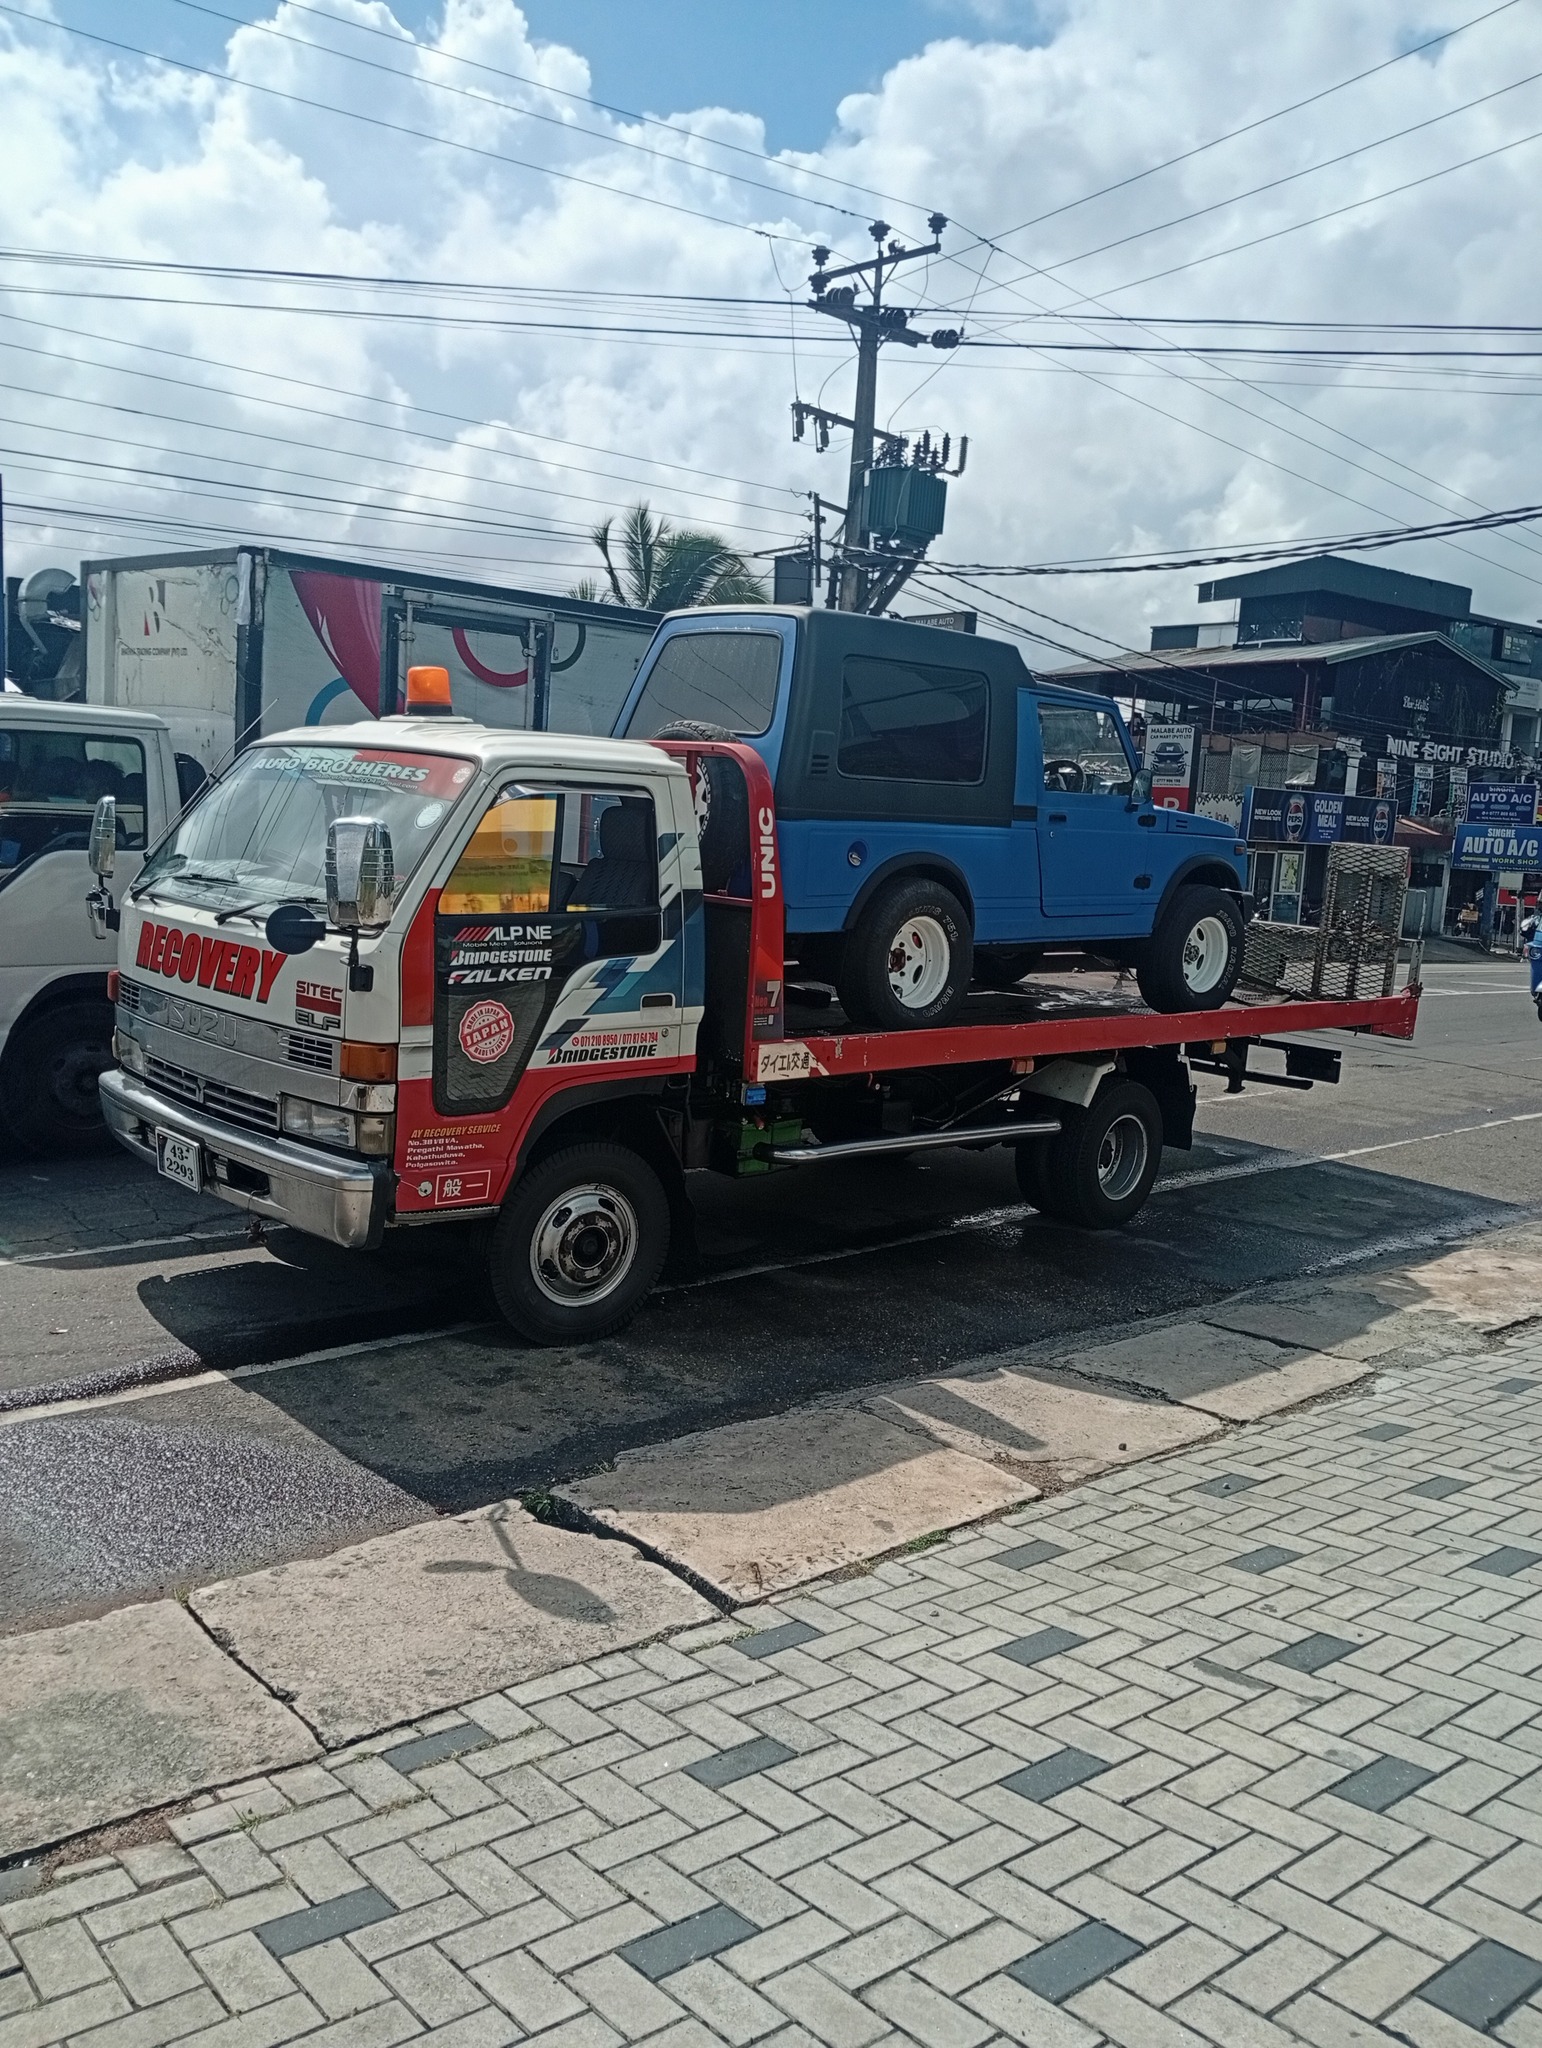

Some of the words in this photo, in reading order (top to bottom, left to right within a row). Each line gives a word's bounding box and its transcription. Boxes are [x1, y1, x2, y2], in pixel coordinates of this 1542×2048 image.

[938, 617, 955, 625] AUTO
[1386, 734, 1419, 760] NINE
[1421, 741, 1464, 763] EIGHT
[1464, 746, 1515, 769] STUDIO
[252, 758, 300, 771] AUTO
[303, 758, 430, 782] BROTHERES
[1314, 799, 1343, 815] GOLDEN
[1471, 792, 1507, 803] AUTO
[1510, 794, 1533, 804] A/C
[1254, 808, 1267, 816] NEW
[1267, 809, 1282, 817] LOOK
[1287, 815, 1303, 825] PEPSI
[1317, 814, 1337, 828] MEAL
[1357, 815, 1370, 823] LOOK
[1375, 821, 1387, 830] PEPSI
[1487, 828, 1516, 838] SINGHE
[758, 807, 776, 898] UNIC
[1462, 836, 1504, 855] AUTO
[1507, 839, 1538, 857] A/C
[1492, 857, 1515, 865] WORK
[1517, 858, 1539, 866] SHOP
[136, 920, 288, 1004] RECOVERY
[450, 949, 552, 966] BRIDGESTONE
[448, 966, 552, 985] FALKEN
[296, 980, 343, 1002] SITEC
[766, 980, 781, 1007] 7
[165, 997, 237, 1046] ISUZU
[295, 1008, 341, 1031] ELF
[466, 1013, 479, 1030] MADE
[477, 1009, 485, 1017] IN
[485, 1008, 500, 1017] JAPAN
[466, 1018, 509, 1046] JAPAN
[580, 1036, 591, 1047] 071
[591, 1035, 602, 1047] 210
[602, 1034, 618, 1046] 8950
[623, 1034, 633, 1045] 077
[632, 1033, 640, 1045] 87
[473, 1046, 488, 1057] MADE
[488, 1047, 496, 1056] IN
[495, 1034, 508, 1052] JAPAN
[547, 1043, 658, 1065] BRIDGESTONE
[411, 1128, 423, 1139] AY
[423, 1126, 468, 1138] RECOVERY
[467, 1123, 502, 1135] SERVICE
[407, 1145, 444, 1154] Pregathi
[166, 1157, 194, 1182] 2293
